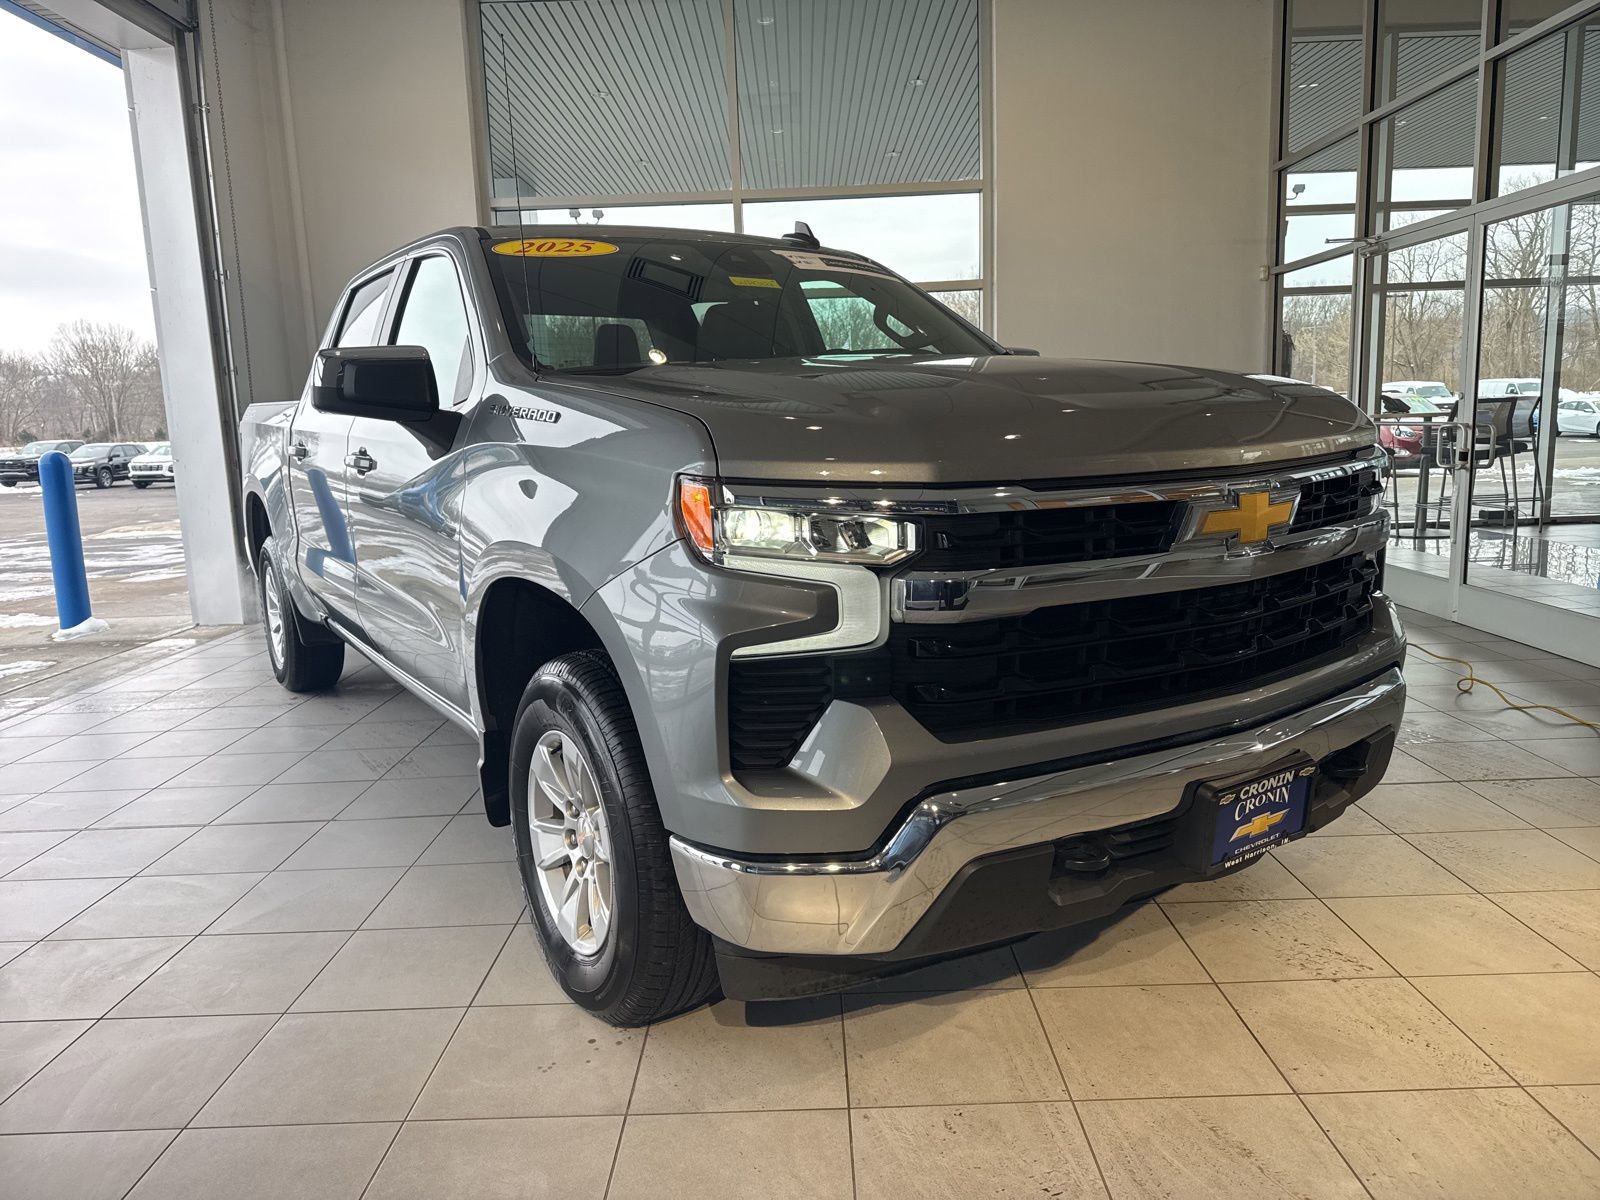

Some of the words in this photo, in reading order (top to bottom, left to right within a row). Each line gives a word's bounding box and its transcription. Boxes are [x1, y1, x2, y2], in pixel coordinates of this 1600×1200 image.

[514, 241, 595, 254] 2025
[1240, 770, 1295, 800] CRONIN
[1234, 785, 1291, 821] CRONIN
[1234, 832, 1281, 855] CHEVROLET
[1224, 856, 1243, 868] West
